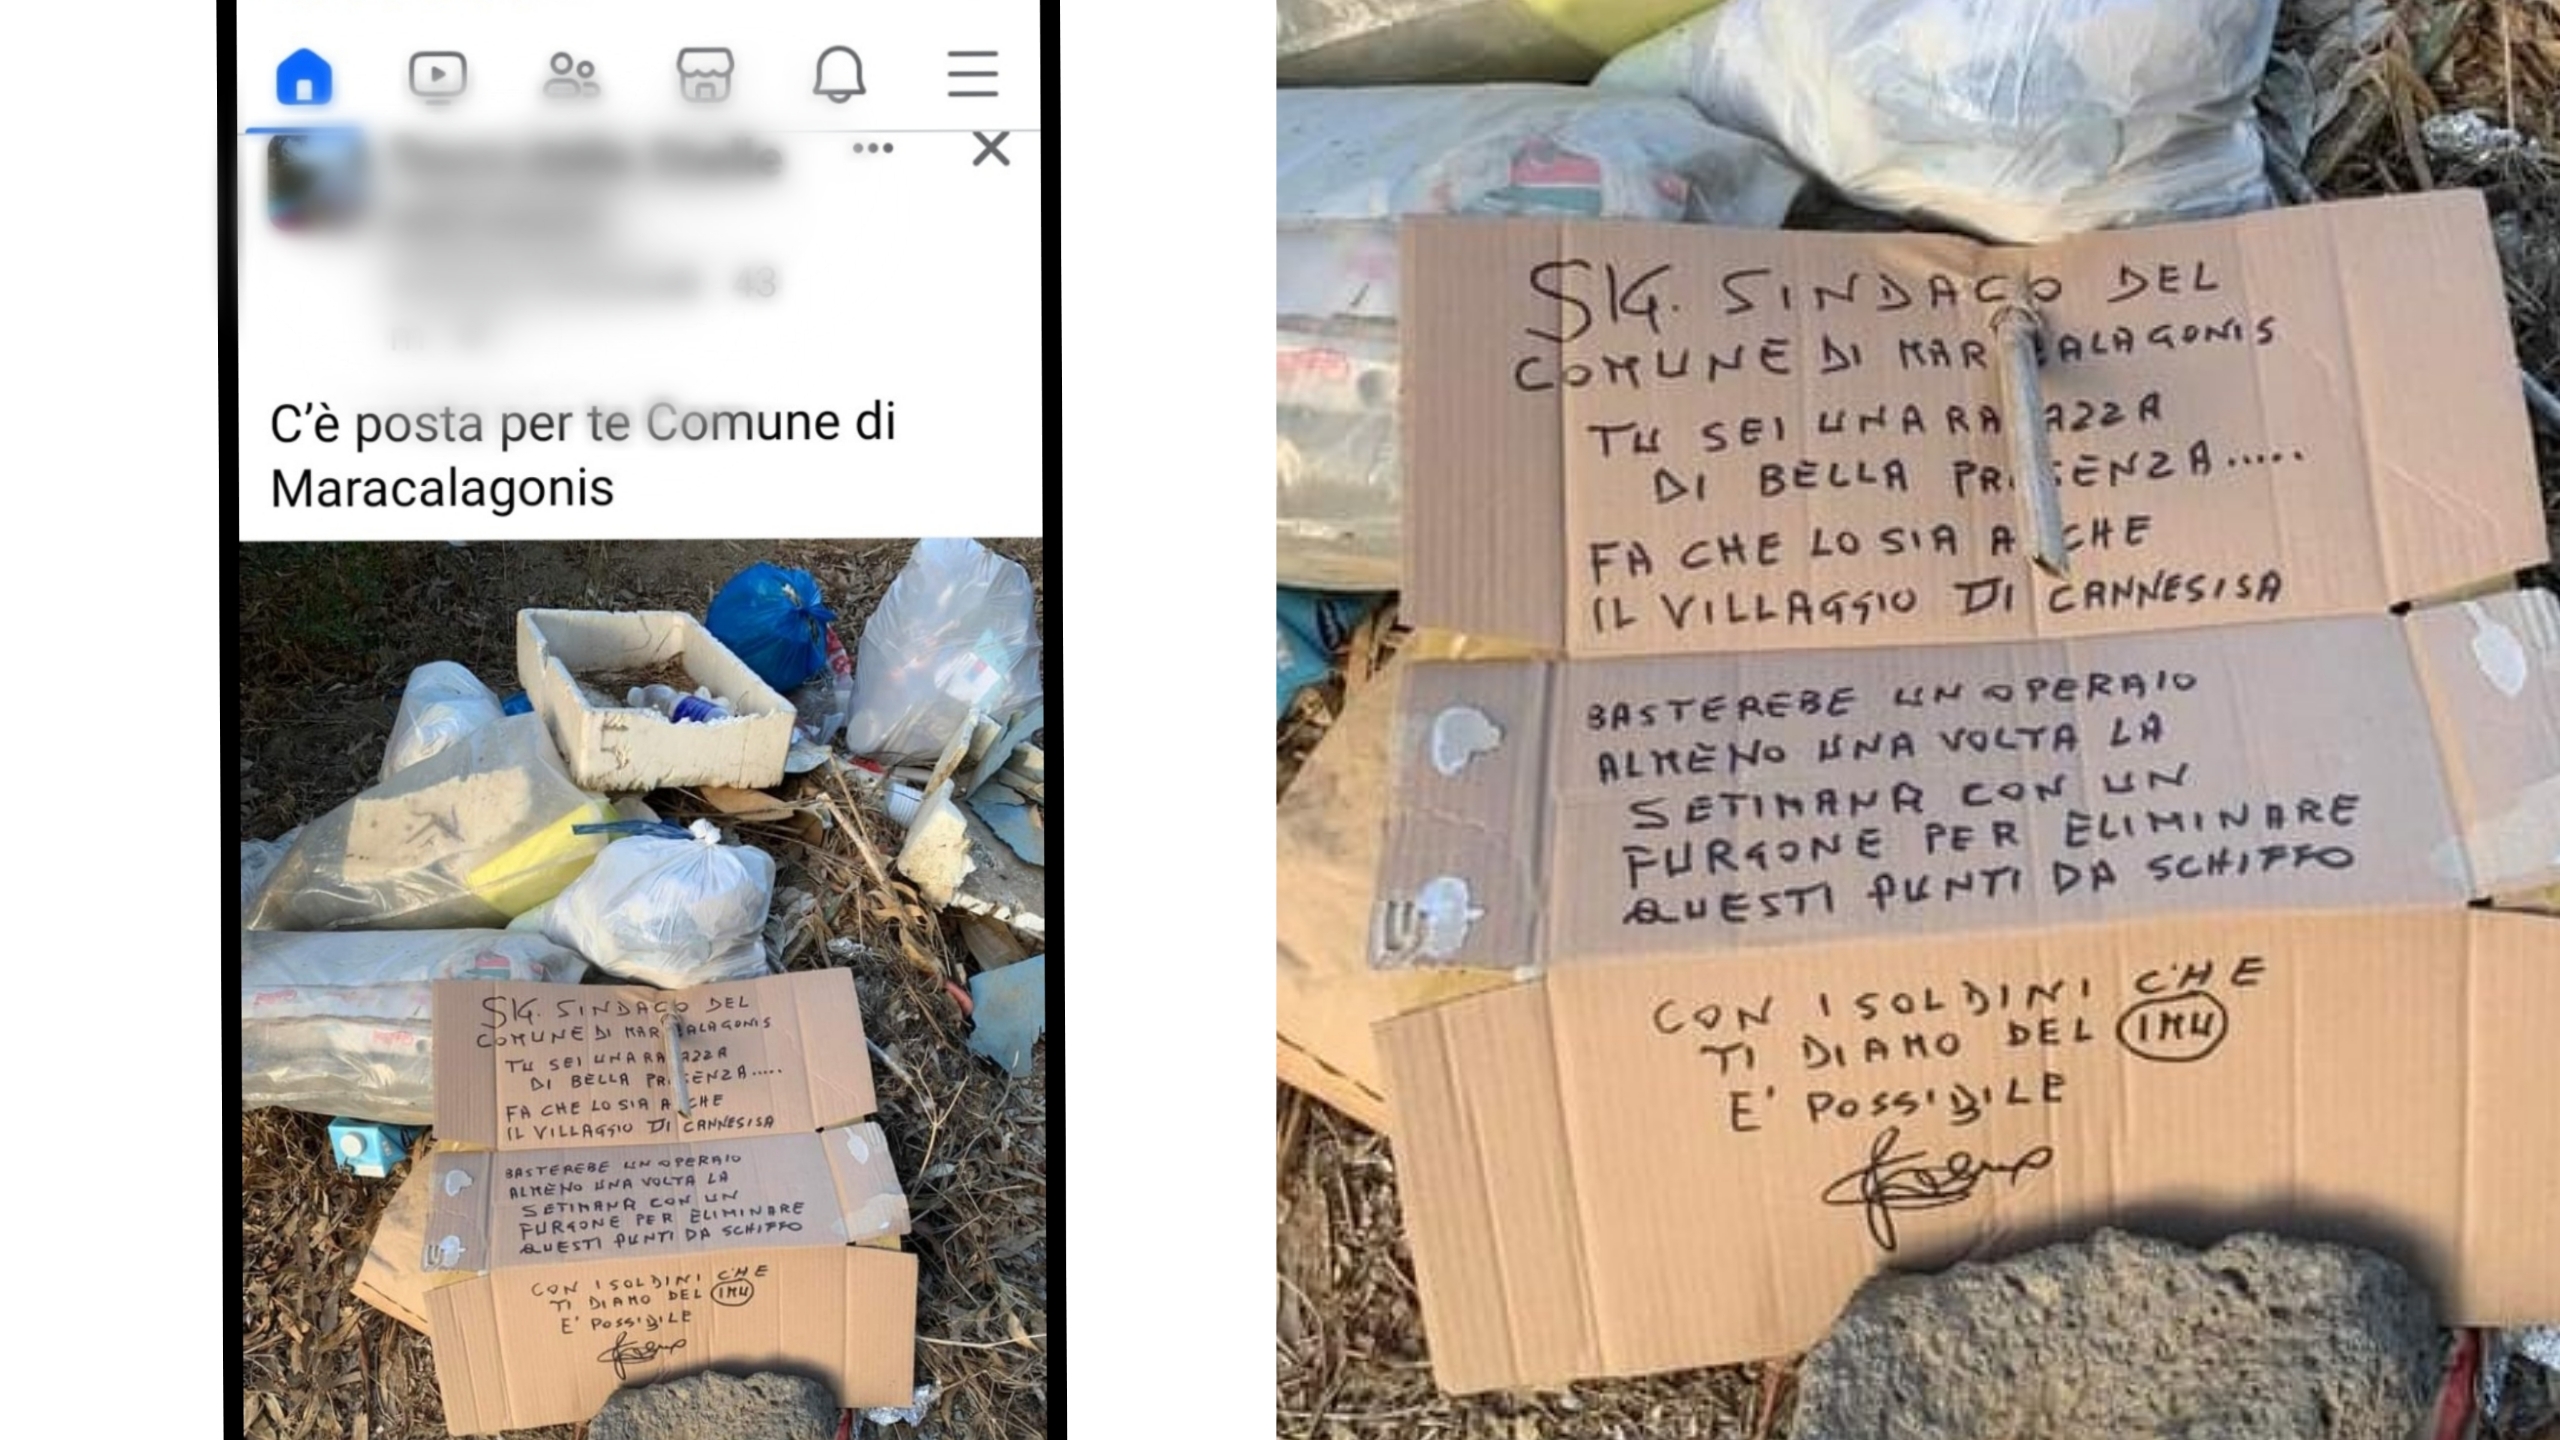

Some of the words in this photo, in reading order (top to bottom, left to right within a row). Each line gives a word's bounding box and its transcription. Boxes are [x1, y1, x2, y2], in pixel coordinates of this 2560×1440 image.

[1721, 268, 2062, 315] SINDACO
[2107, 261, 2219, 303] DEL
[1514, 338, 1791, 392] COMUNE
[1820, 332, 1862, 374] DI
[355, 407, 484, 453] posta
[500, 407, 573, 453] per
[587, 407, 631, 443] te
[646, 402, 840, 442] Comune
[854, 402, 897, 441] di
[1588, 421, 1661, 457] TU
[1702, 415, 1786, 453] SEI
[1945, 391, 2163, 436] RAAZZA
[271, 468, 615, 517] Maracalagonis
[1653, 467, 1705, 502] DI
[1759, 459, 1908, 497] BELLA
[1588, 540, 1653, 584] FA
[1680, 532, 1783, 571] CHE
[1810, 527, 1860, 557] LO
[1879, 524, 1957, 557] SIA
[1991, 515, 2152, 556] ACHE
[1593, 597, 1637, 633] IL
[1660, 589, 1918, 630] VILLAGGIO
[1954, 577, 2014, 615] DI
[2048, 569, 2283, 613] CANNESISA
[1587, 687, 1856, 731] BASTEREBE
[1894, 682, 1963, 707] UN
[1982, 670, 2198, 703] OPERAIO
[1940, 723, 2079, 753] VOLTA
[2110, 711, 2164, 747] LA
[1961, 774, 2066, 808] CON
[2103, 762, 2190, 795] UN
[1622, 828, 1883, 890] FURGONE
[1924, 821, 2018, 855] PER
[2064, 793, 2361, 849] ELIMINARE
[1622, 881, 1834, 925] QUESTI
[1866, 867, 2021, 912] PUNTI
[2053, 860, 2117, 896] DA
[2146, 843, 2354, 882] SCHIFFO
[556, 999, 688, 1017] SINDACO
[706, 996, 749, 1012] DEL
[1653, 995, 1774, 1035] CON
[1818, 991, 1831, 1018] I
[1854, 977, 2092, 1016] SOLDINI
[477, 1027, 584, 1048] COMUNE
[595, 1024, 611, 1040] DI
[1700, 1043, 1756, 1074] TI
[1802, 1033, 1962, 1070] DIAMO
[2007, 1017, 2096, 1047] DEL
[2137, 1010, 2215, 1043] IMU
[505, 1059, 533, 1073] TU
[549, 1056, 582, 1071] SEI
[643, 1046, 727, 1064] RAAZZA
[530, 1077, 551, 1090] DI
[571, 1073, 629, 1088] BELLA
[1807, 1072, 2068, 1126] POSSIBILE
[506, 1105, 531, 1122] FA
[591, 1100, 611, 1111] LO
[618, 1098, 648, 1111] SIA
[661, 1094, 723, 1110] ACHE
[508, 1127, 525, 1141] IL
[533, 1124, 633, 1139] VILLAGGIO
[647, 1119, 670, 1133] DI
[683, 1115, 774, 1132] CANNESISA
[505, 1162, 609, 1179] BASTEREBE
[624, 1159, 651, 1169] UN
[658, 1154, 742, 1167] OPERAIO
[642, 1175, 696, 1187] VOLTA
[708, 1170, 728, 1184] LA
[650, 1195, 691, 1208] CON
[705, 1190, 739, 1203] UN
[519, 1216, 620, 1240] FURGONE
[636, 1213, 672, 1226] PER
[690, 1202, 805, 1223] ELIMINARE
[519, 1237, 601, 1254] QUESTI
[686, 1228, 711, 1242] DA
[722, 1221, 802, 1236] SCHIFFO
[532, 1281, 578, 1296] CON
[609, 1273, 701, 1289] SOLDINI
[550, 1300, 571, 1312] TI
[589, 1295, 651, 1310] DIAMO
[668, 1289, 703, 1300] DEL
[591, 1310, 692, 1331] POSSIBILE
